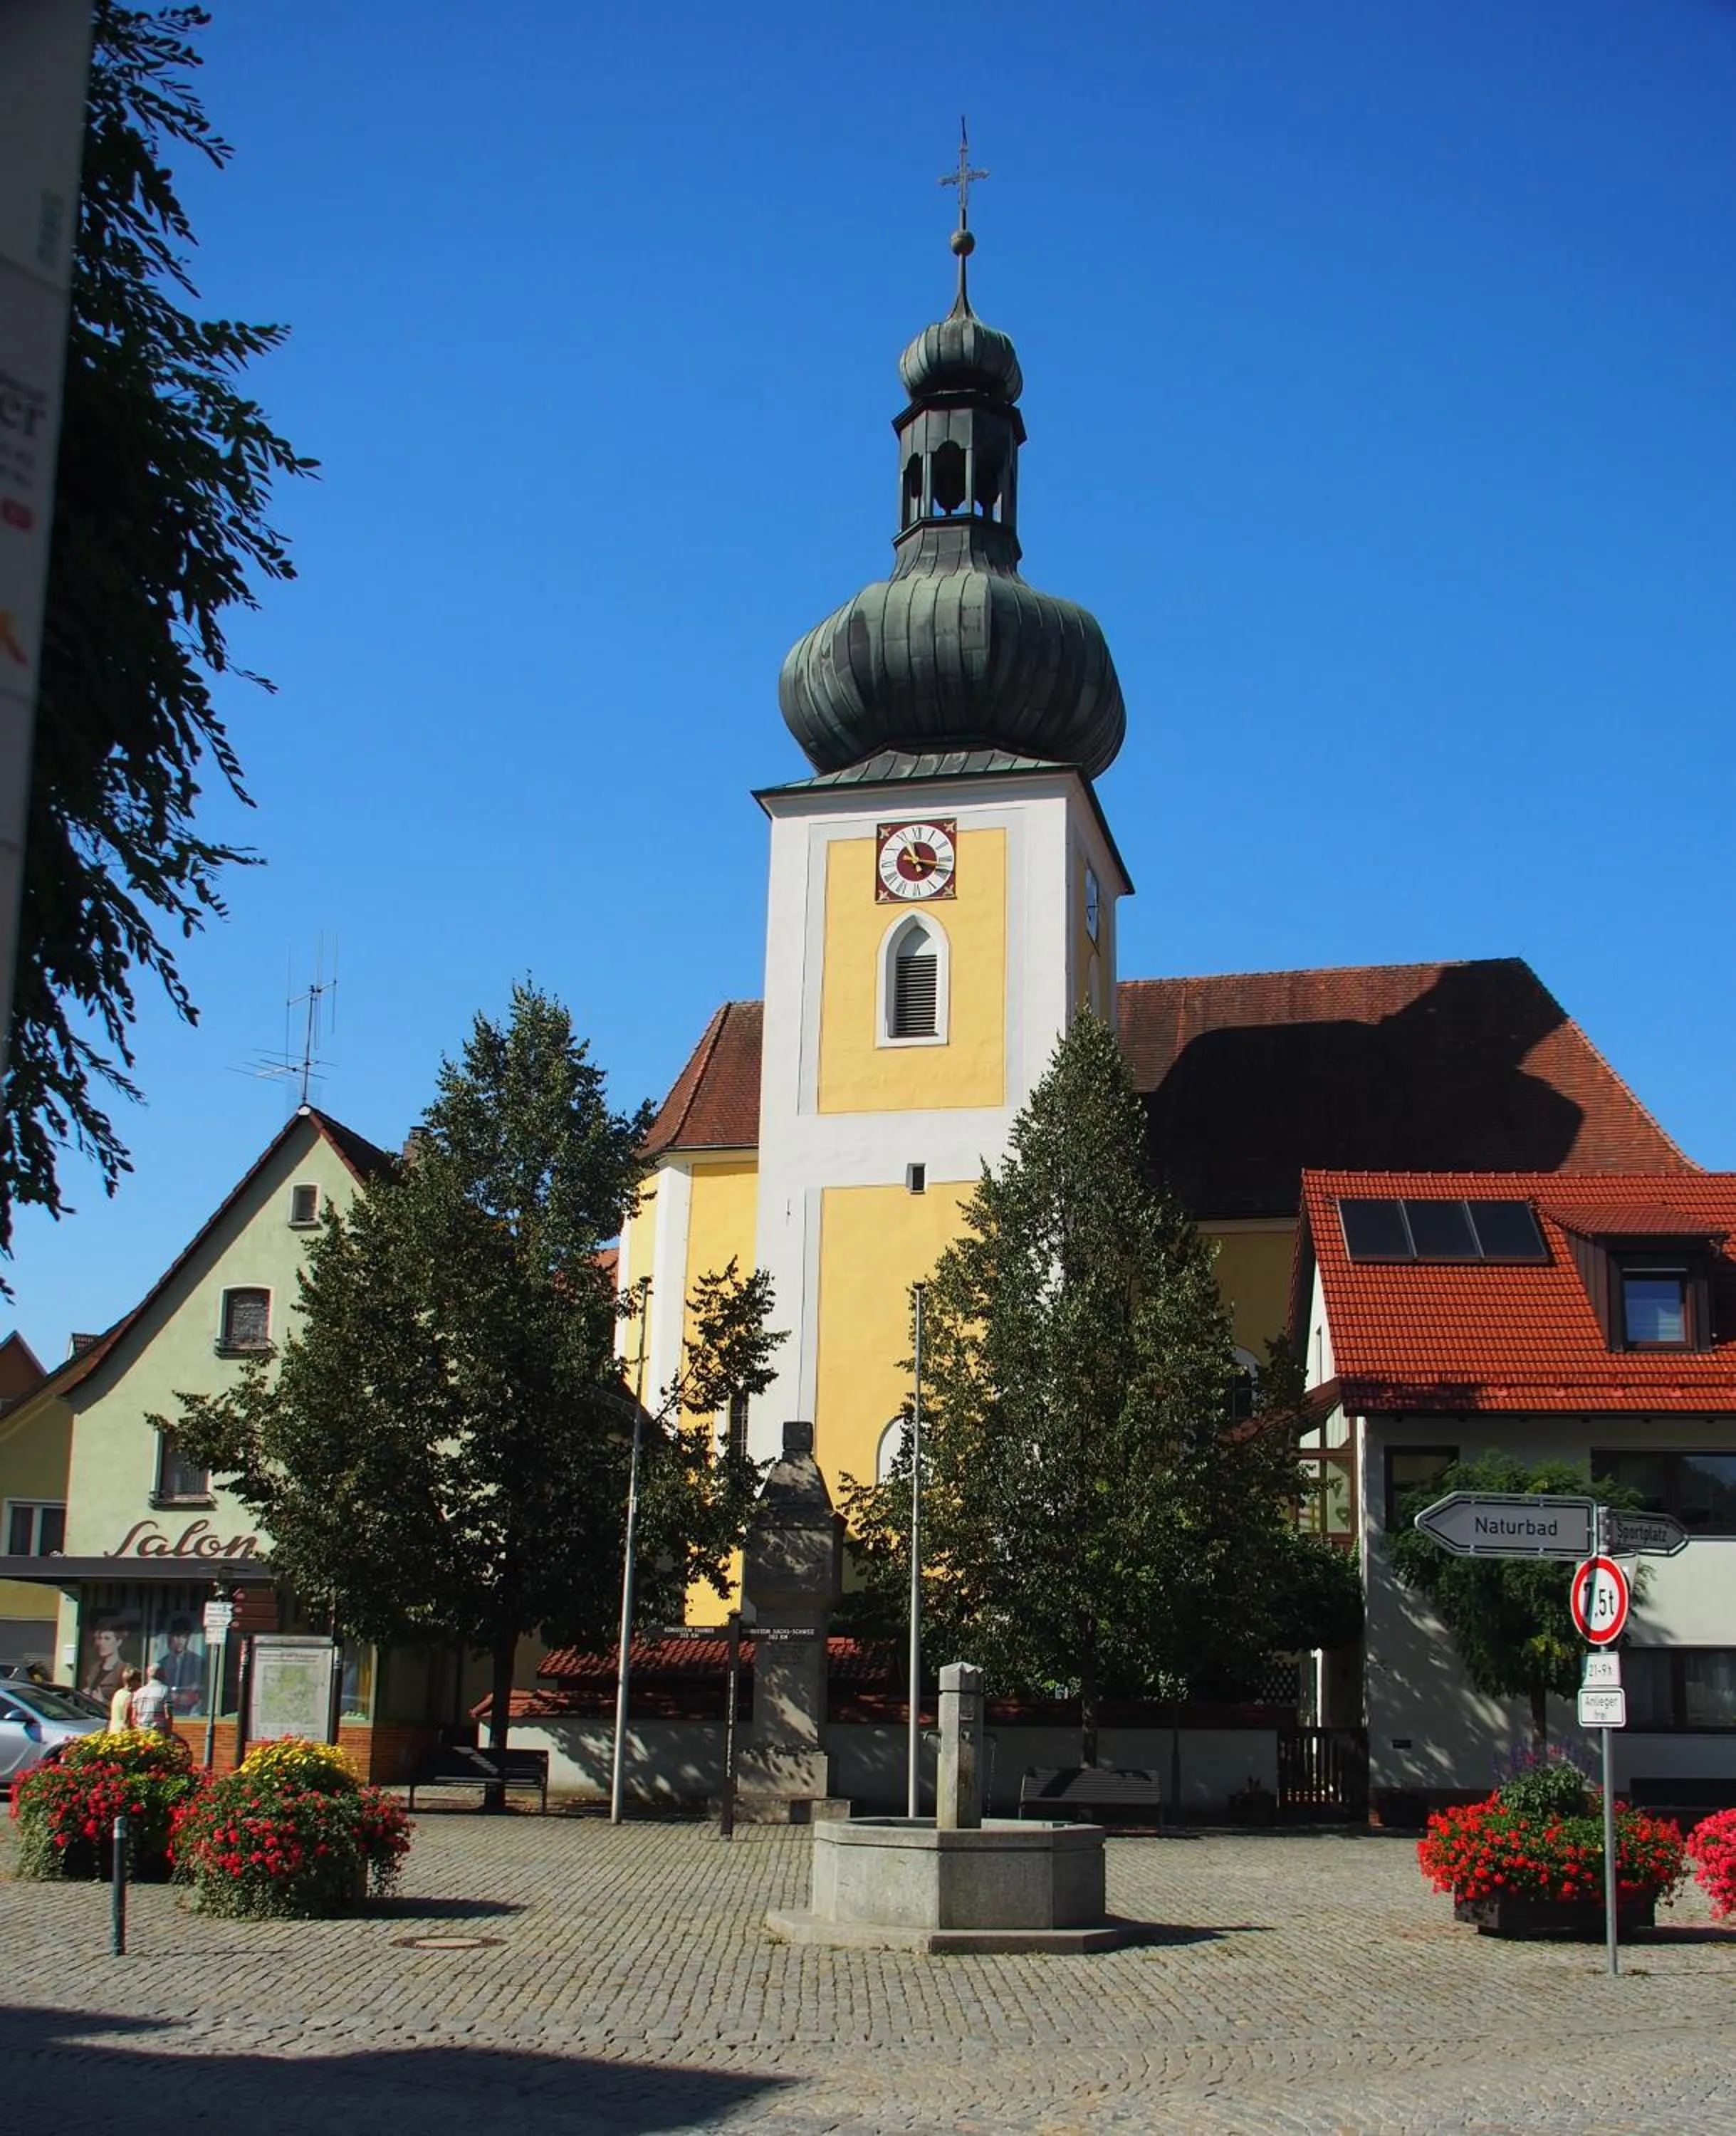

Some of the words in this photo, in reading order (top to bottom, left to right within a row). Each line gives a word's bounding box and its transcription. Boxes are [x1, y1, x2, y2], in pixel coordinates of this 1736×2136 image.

[1475, 1516, 1558, 1536] Naturbad
[1617, 1522, 1668, 1544] Sportplatz
[103, 1519, 258, 1558] Salon
[1585, 1696, 1619, 1710] Anlieger
